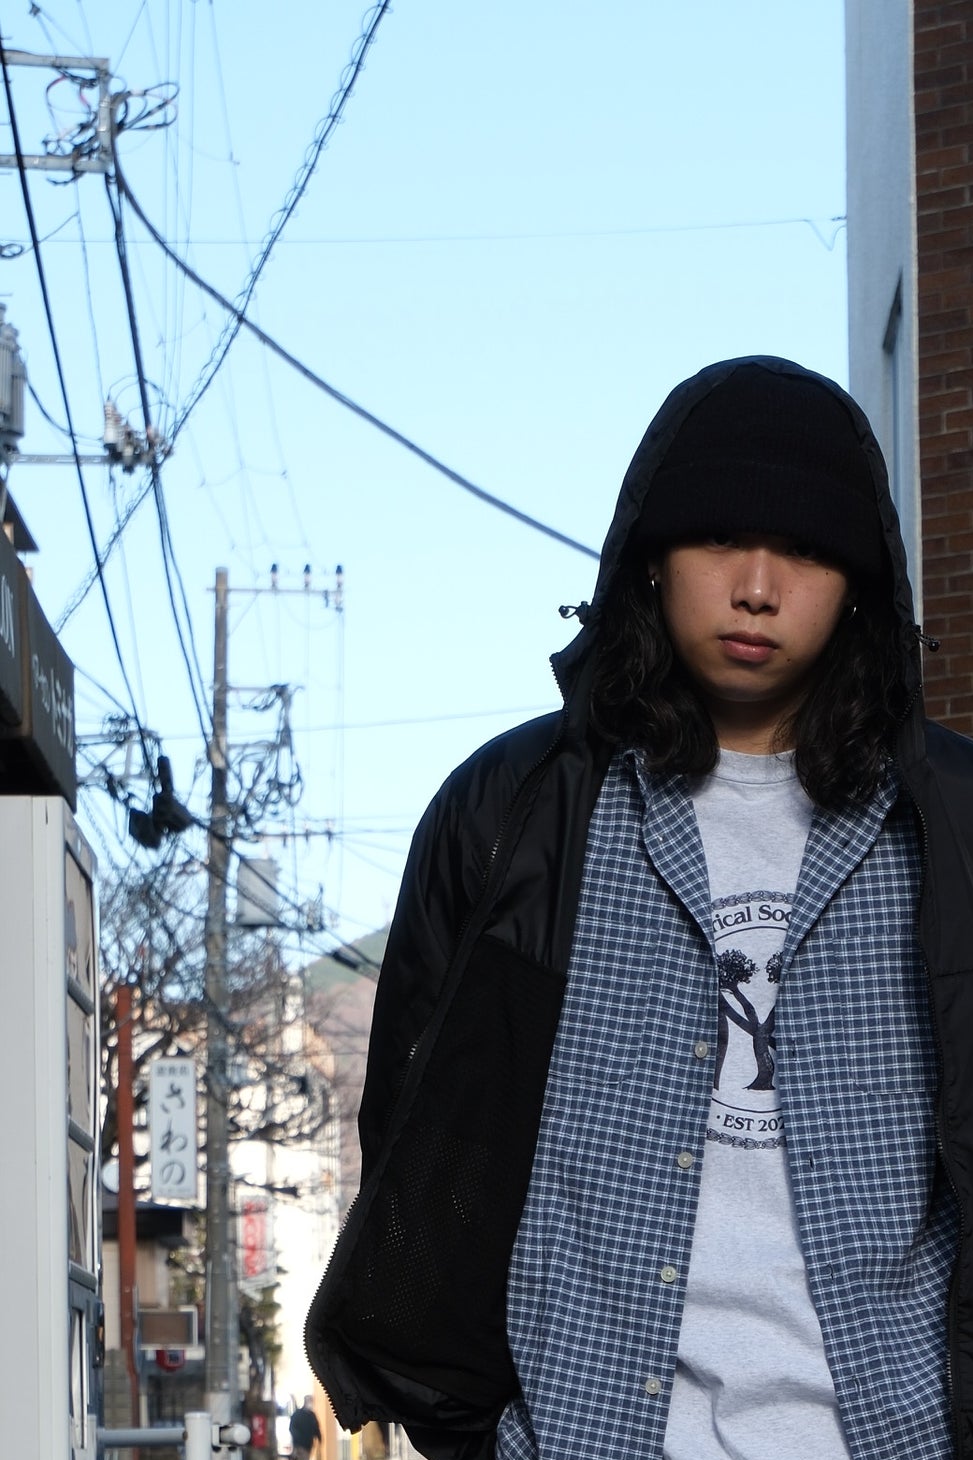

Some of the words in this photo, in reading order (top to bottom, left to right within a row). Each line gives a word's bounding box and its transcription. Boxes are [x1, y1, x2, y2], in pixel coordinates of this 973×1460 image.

[0, 574, 15, 658] ON
[160, 1082, 188, 1187] さわの
[723, 1114, 754, 1131] EST
